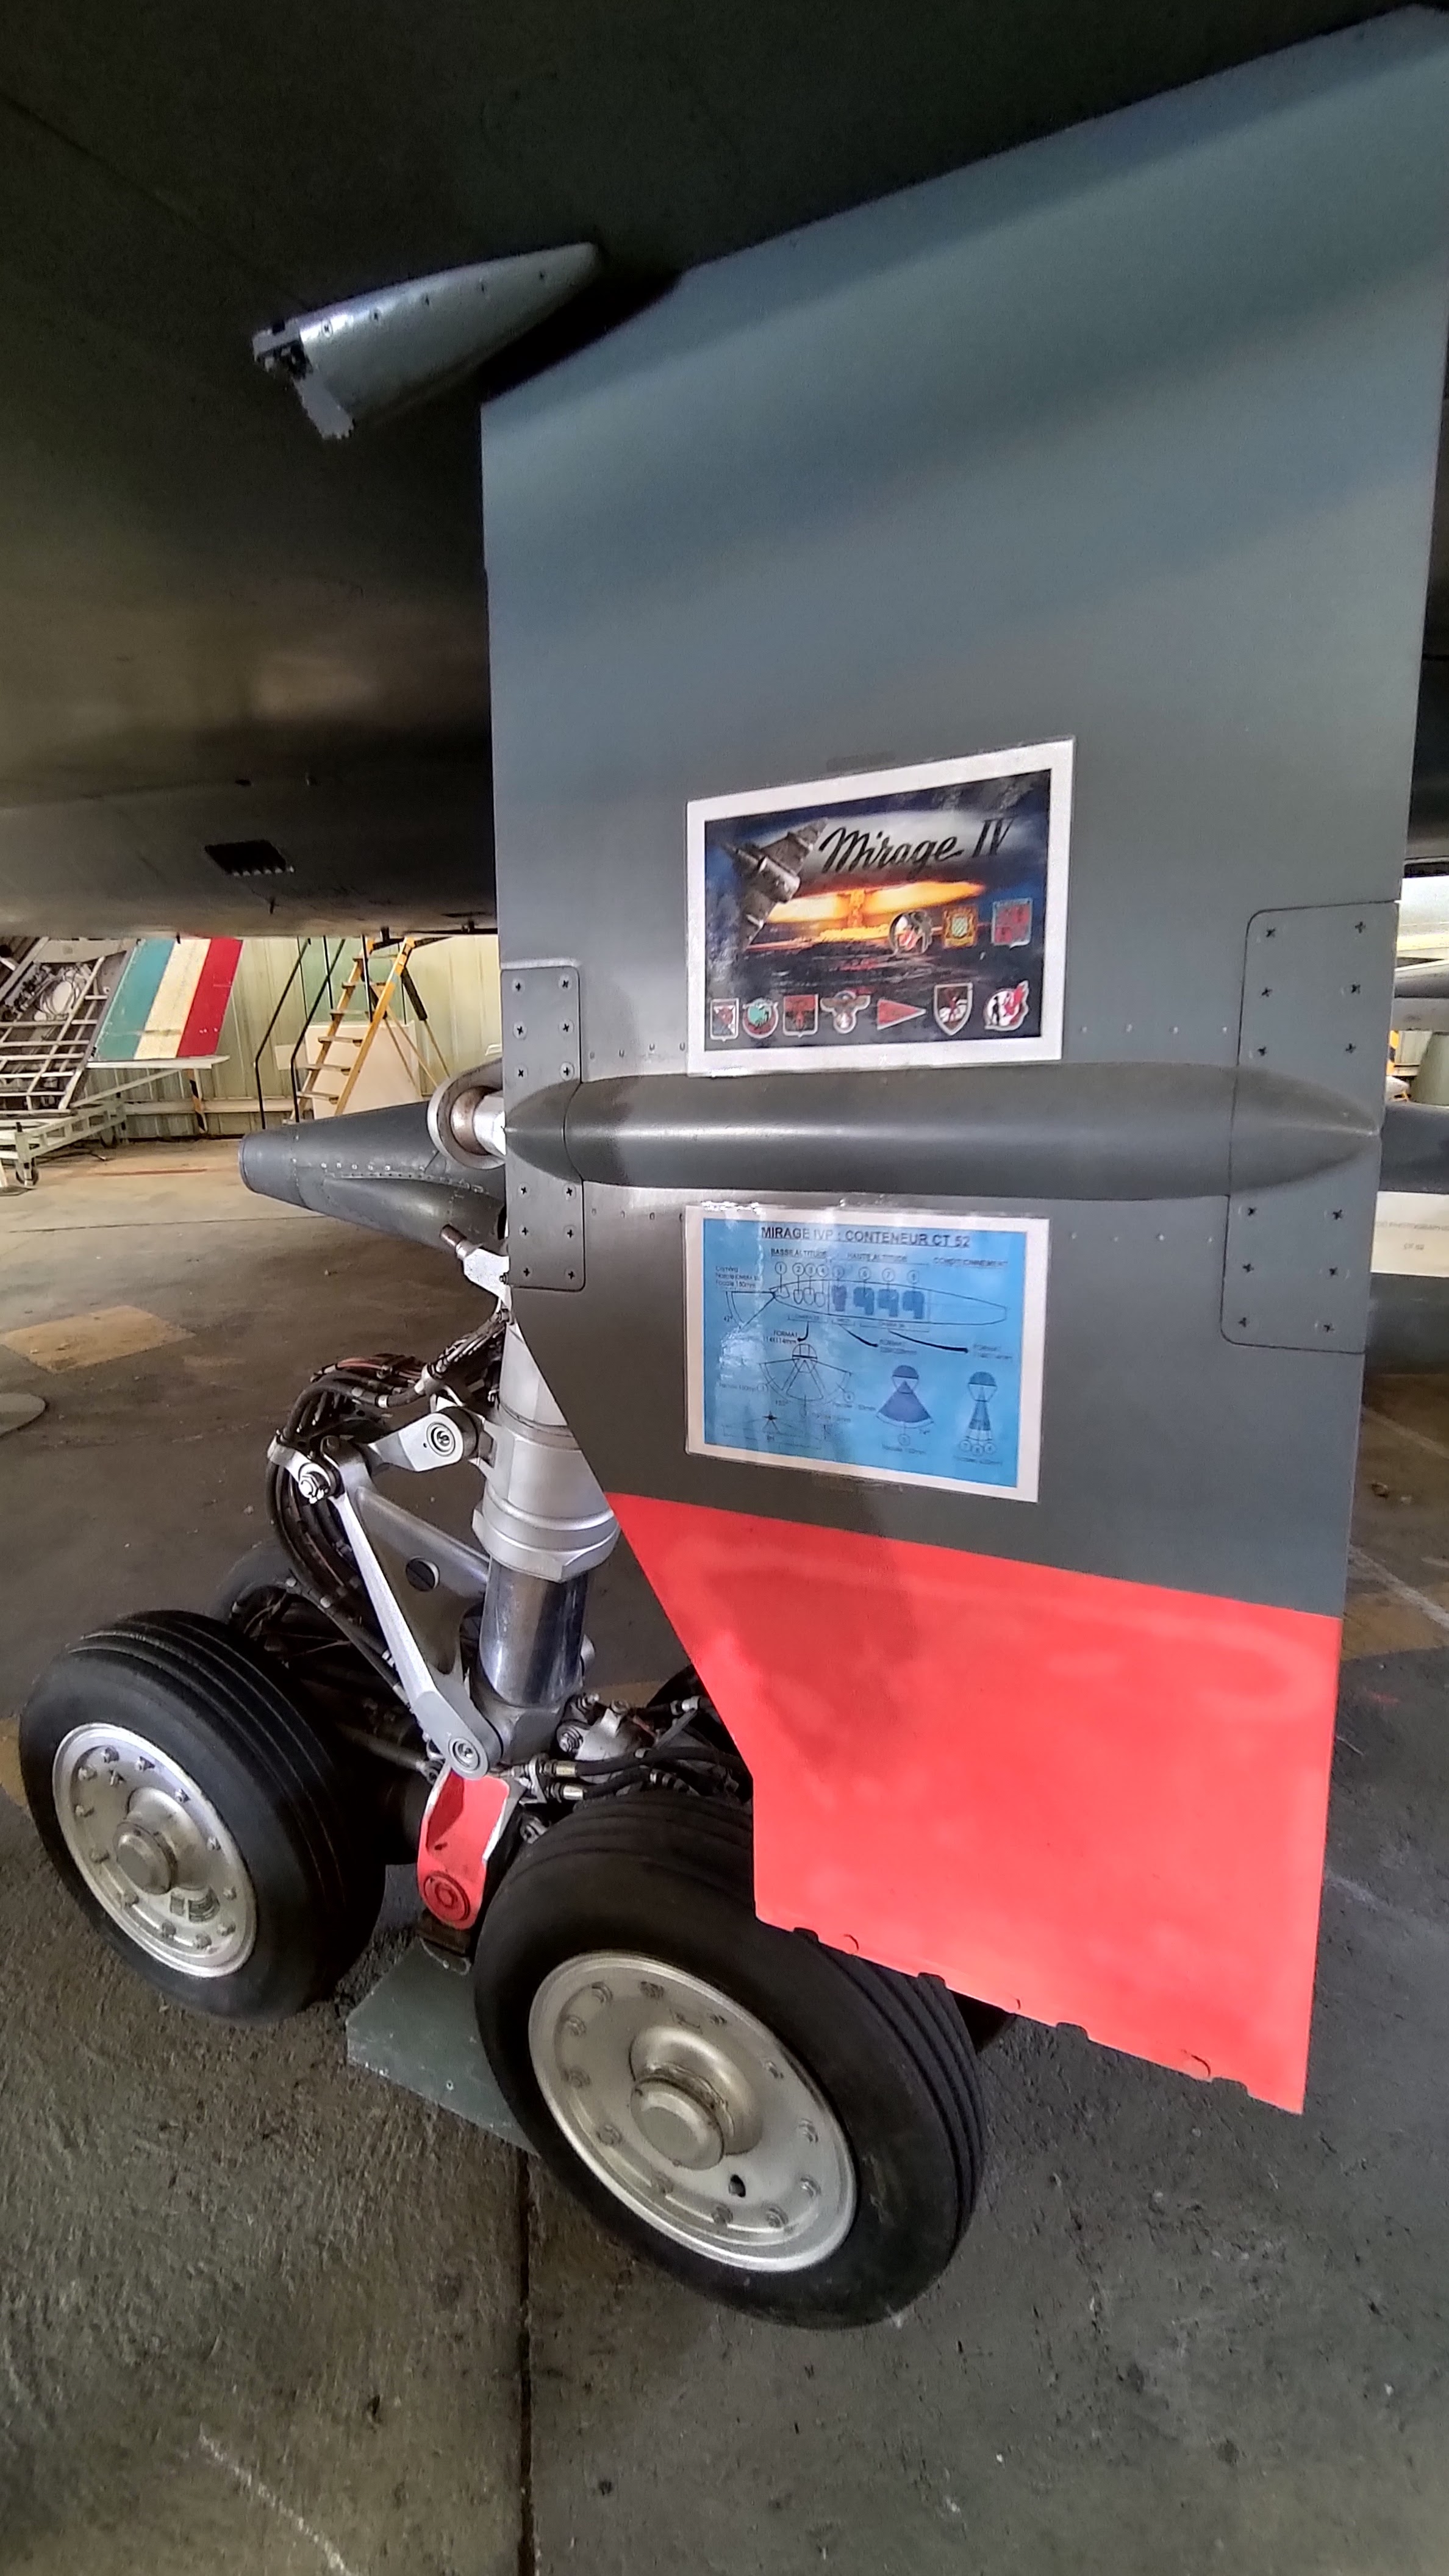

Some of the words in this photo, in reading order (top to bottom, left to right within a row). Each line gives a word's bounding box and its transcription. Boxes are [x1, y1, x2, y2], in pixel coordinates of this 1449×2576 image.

[818, 826, 964, 875] Mirage
[973, 817, 1017, 858] IV
[762, 1227, 809, 1239] MIRAGE
[814, 1228, 834, 1240] IVP
[846, 1230, 928, 1245] CONTENEUR
[932, 1234, 951, 1247] CT
[955, 1236, 970, 1247] 52
